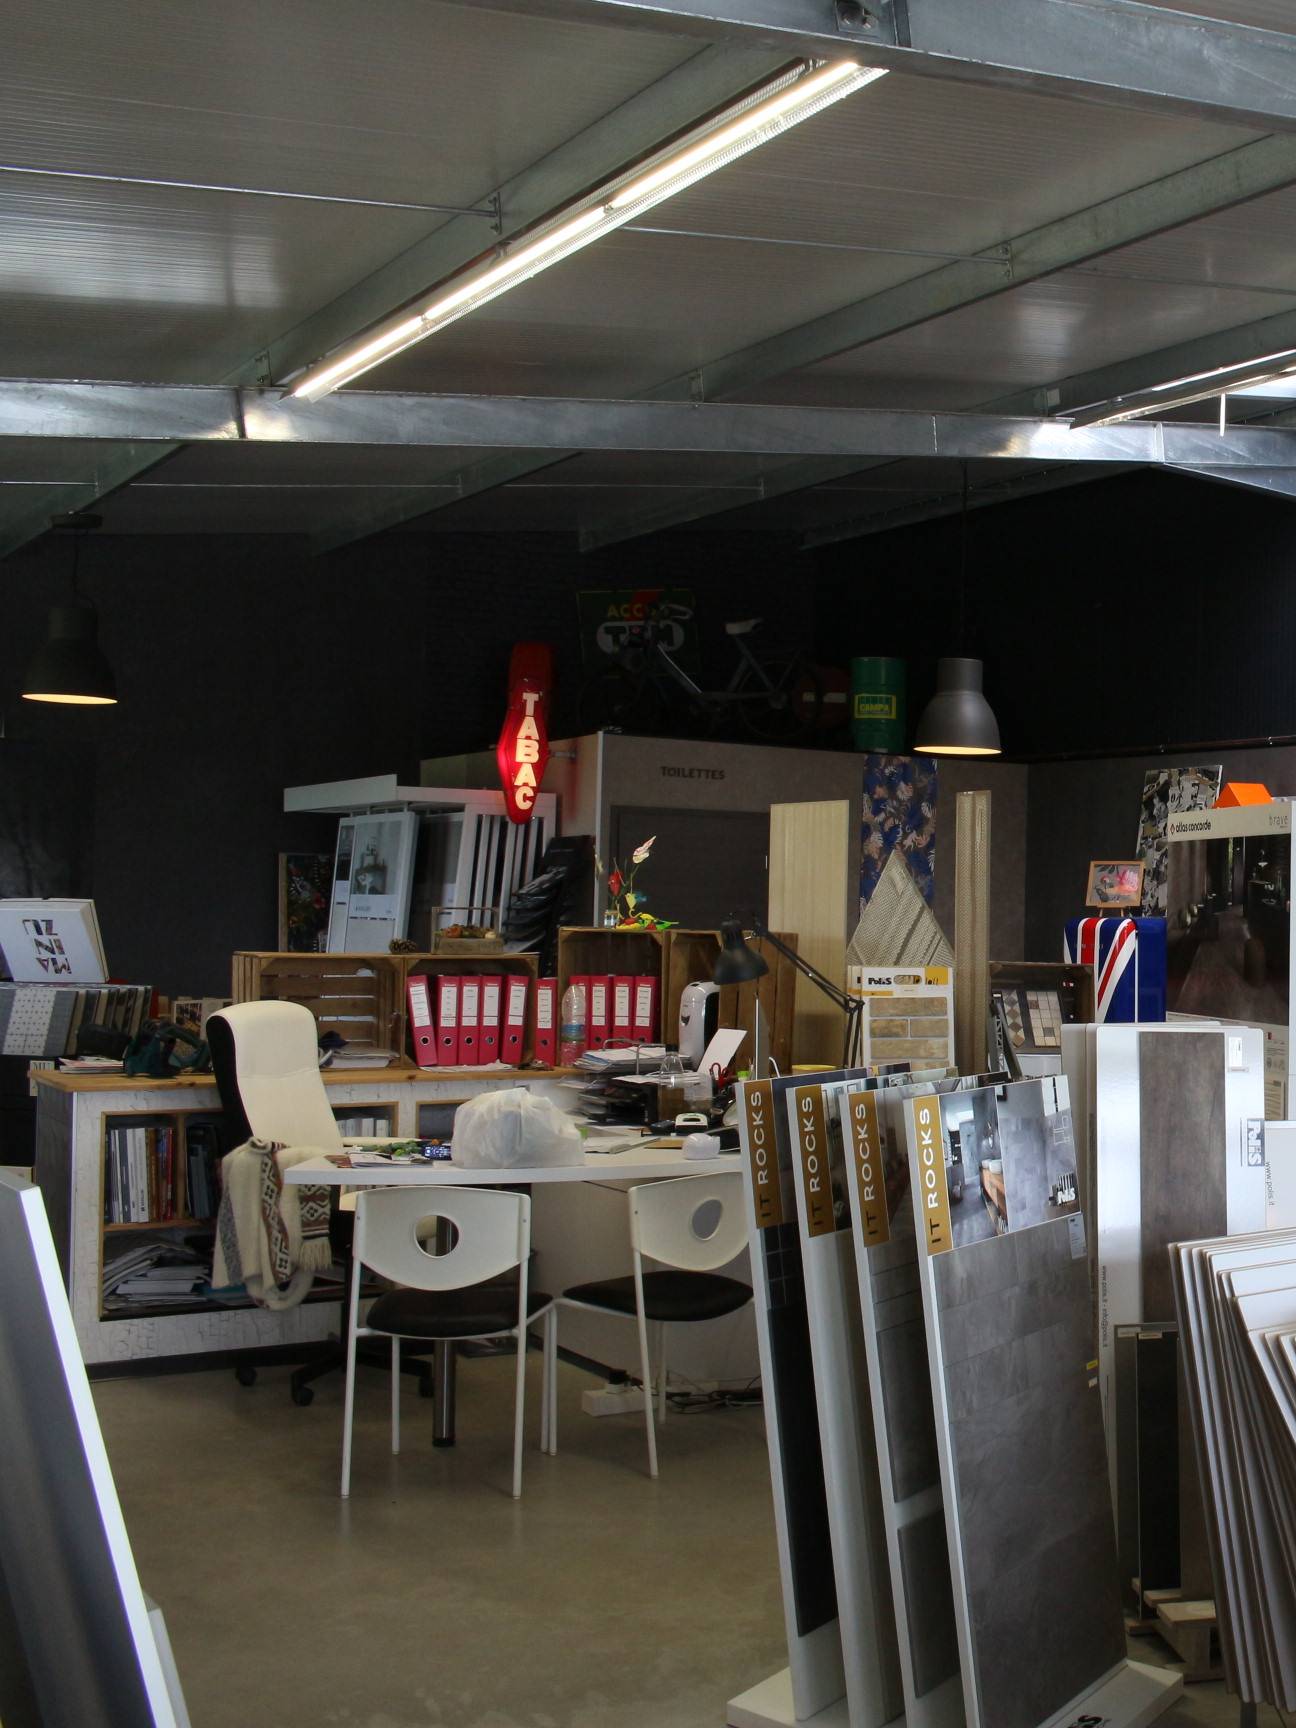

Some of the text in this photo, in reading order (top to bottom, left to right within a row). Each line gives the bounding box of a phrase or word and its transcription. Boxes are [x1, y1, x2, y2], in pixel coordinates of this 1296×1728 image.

[513, 692, 540, 811] TABAC
[660, 766, 726, 780] TOILETTES
[1188, 819, 1212, 832] concorde
[751, 1091, 772, 1218] IT ROCKS
[802, 1096, 824, 1226] IT ROCKS
[855, 1103, 879, 1236] IT ROCKS
[920, 1107, 942, 1244] IT ROCKS
